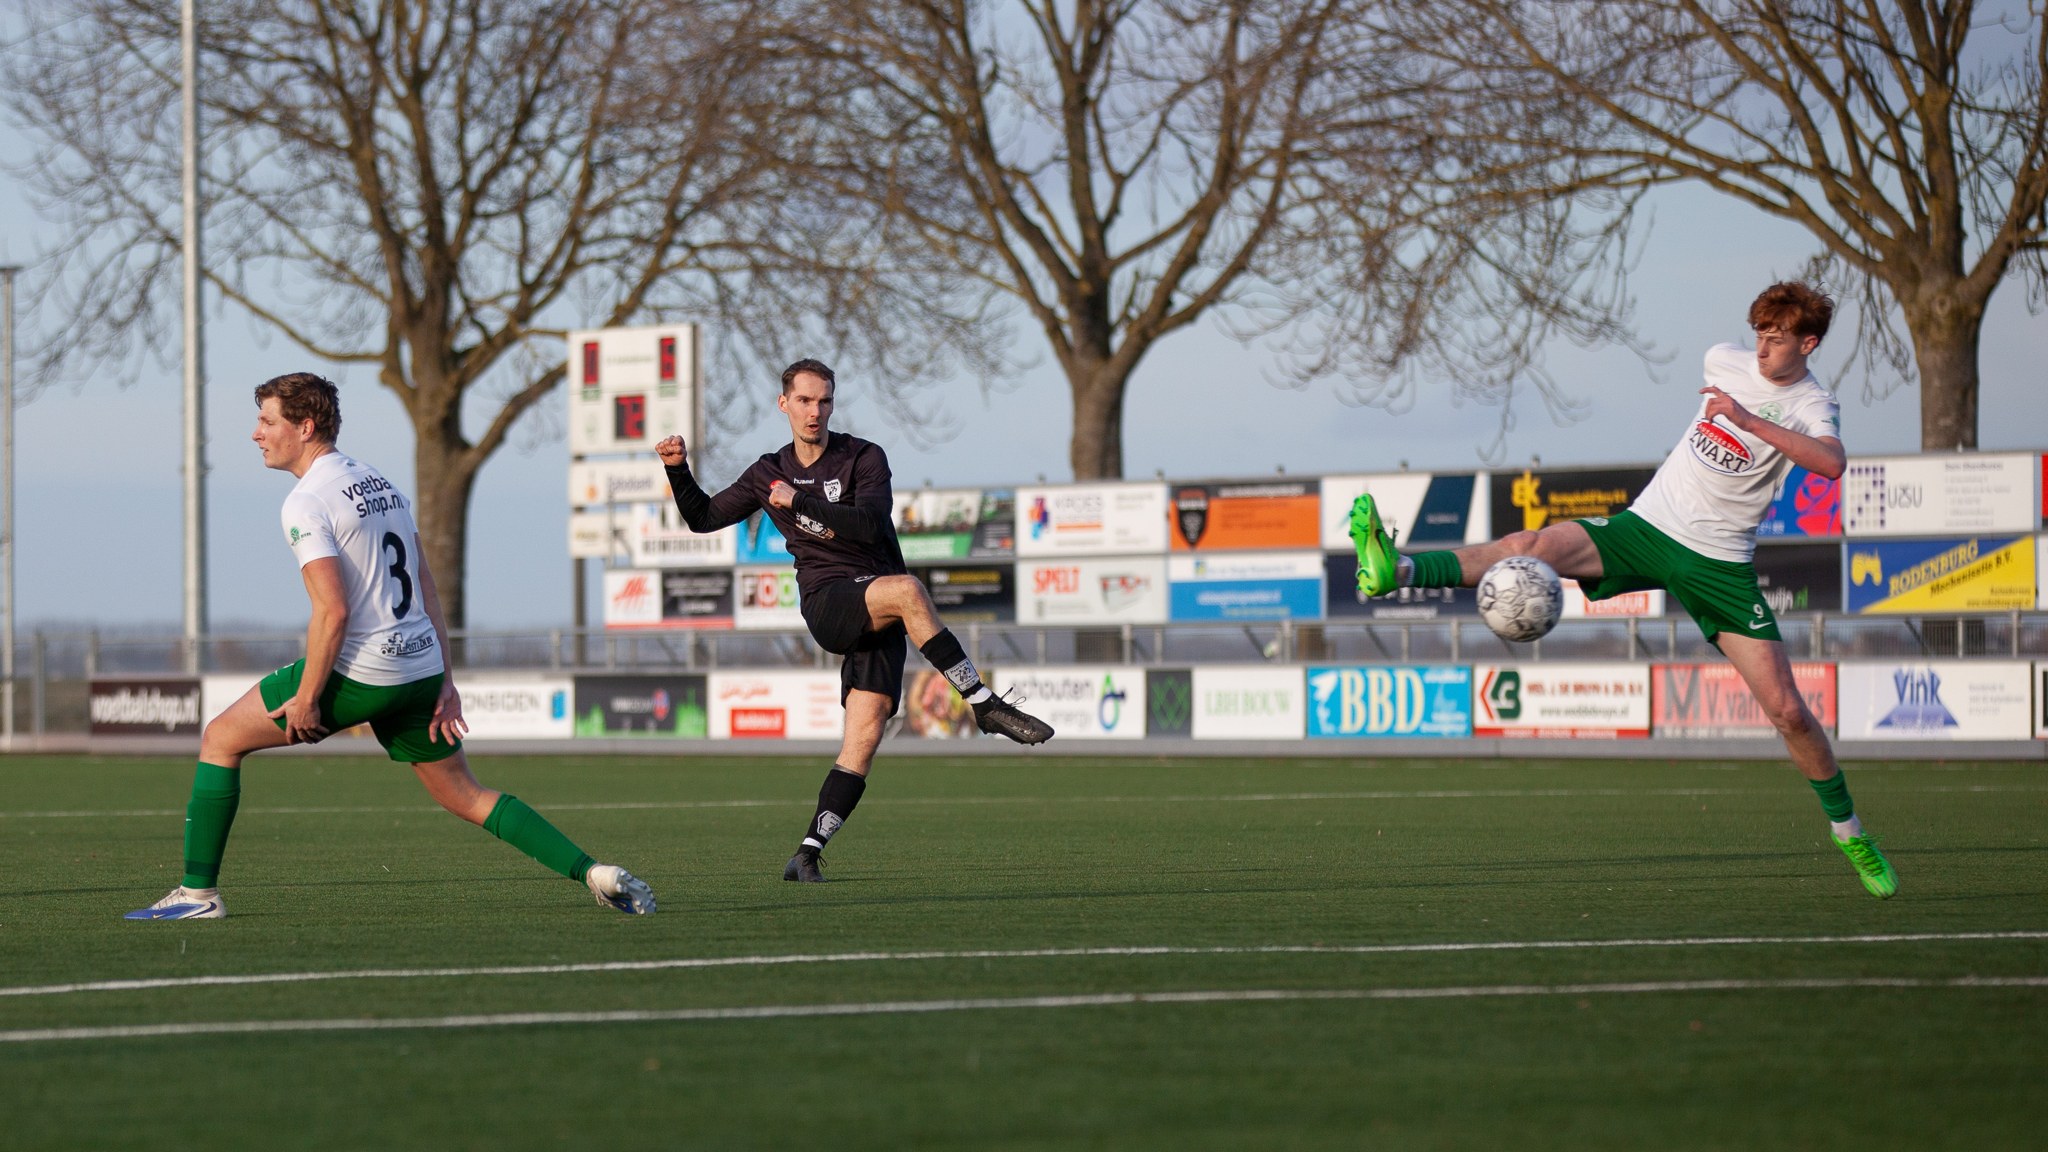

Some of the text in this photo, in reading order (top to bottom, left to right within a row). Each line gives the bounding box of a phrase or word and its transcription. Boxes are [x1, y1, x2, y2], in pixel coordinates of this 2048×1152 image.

[342, 475, 392, 501] voetba
[382, 531, 412, 620] 3
[1034, 567, 1079, 593] SPELT
[1889, 537, 1979, 598] RODENBURG
[1753, 604, 1764, 619] 9
[91, 687, 199, 732] voetbalshop.nl
[1339, 668, 1426, 734] BBD
